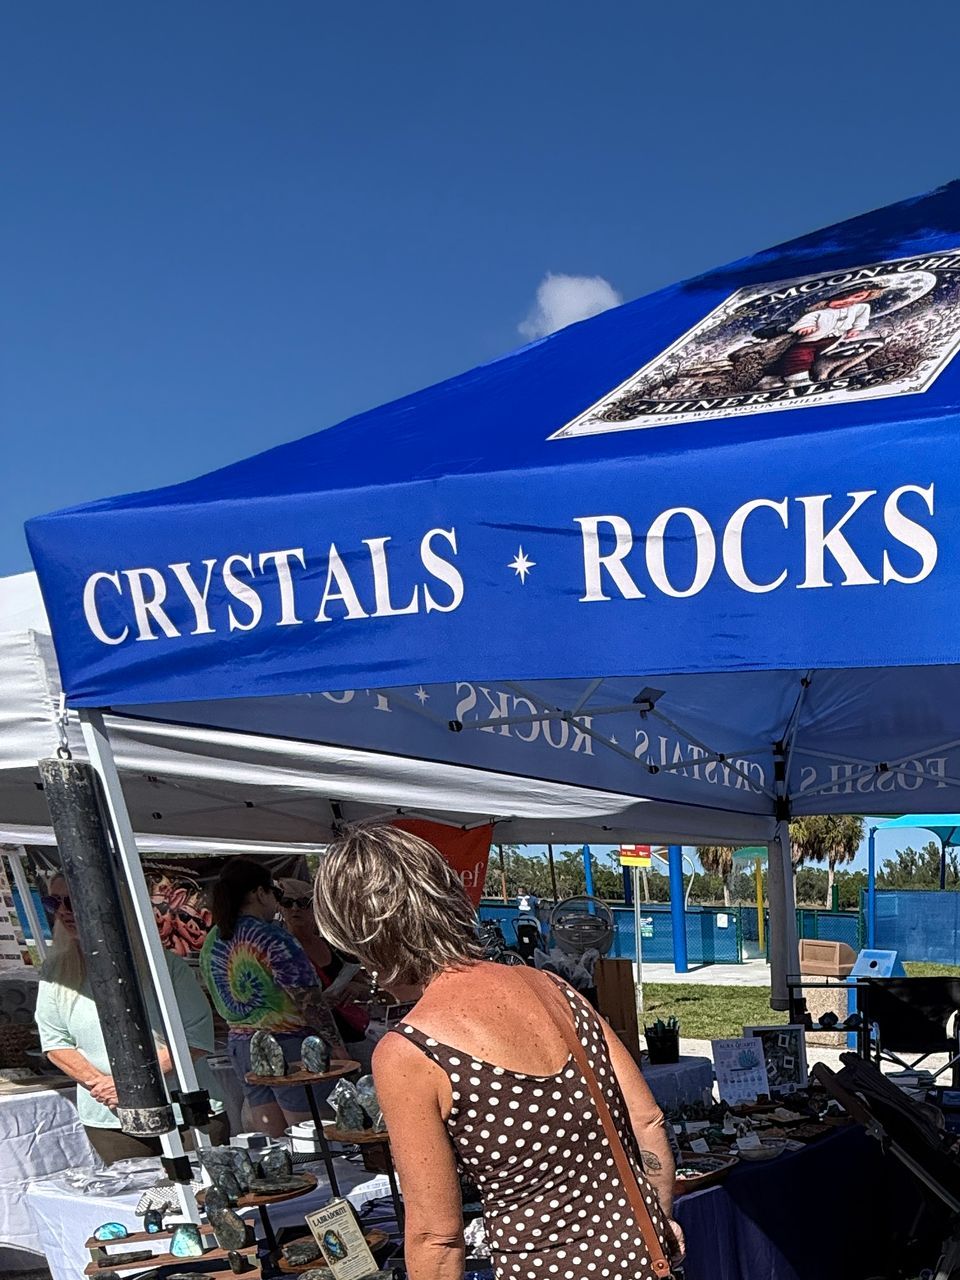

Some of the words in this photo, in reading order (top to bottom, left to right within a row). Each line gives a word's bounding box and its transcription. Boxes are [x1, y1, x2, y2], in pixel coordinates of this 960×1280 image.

[768, 265, 881, 302] MOON
[648, 378, 849, 414] MINERALS
[83, 527, 464, 645] CRYSTALS
[573, 482, 938, 602] ROCKS
[312, 1206, 347, 1227] LABRADORITE
